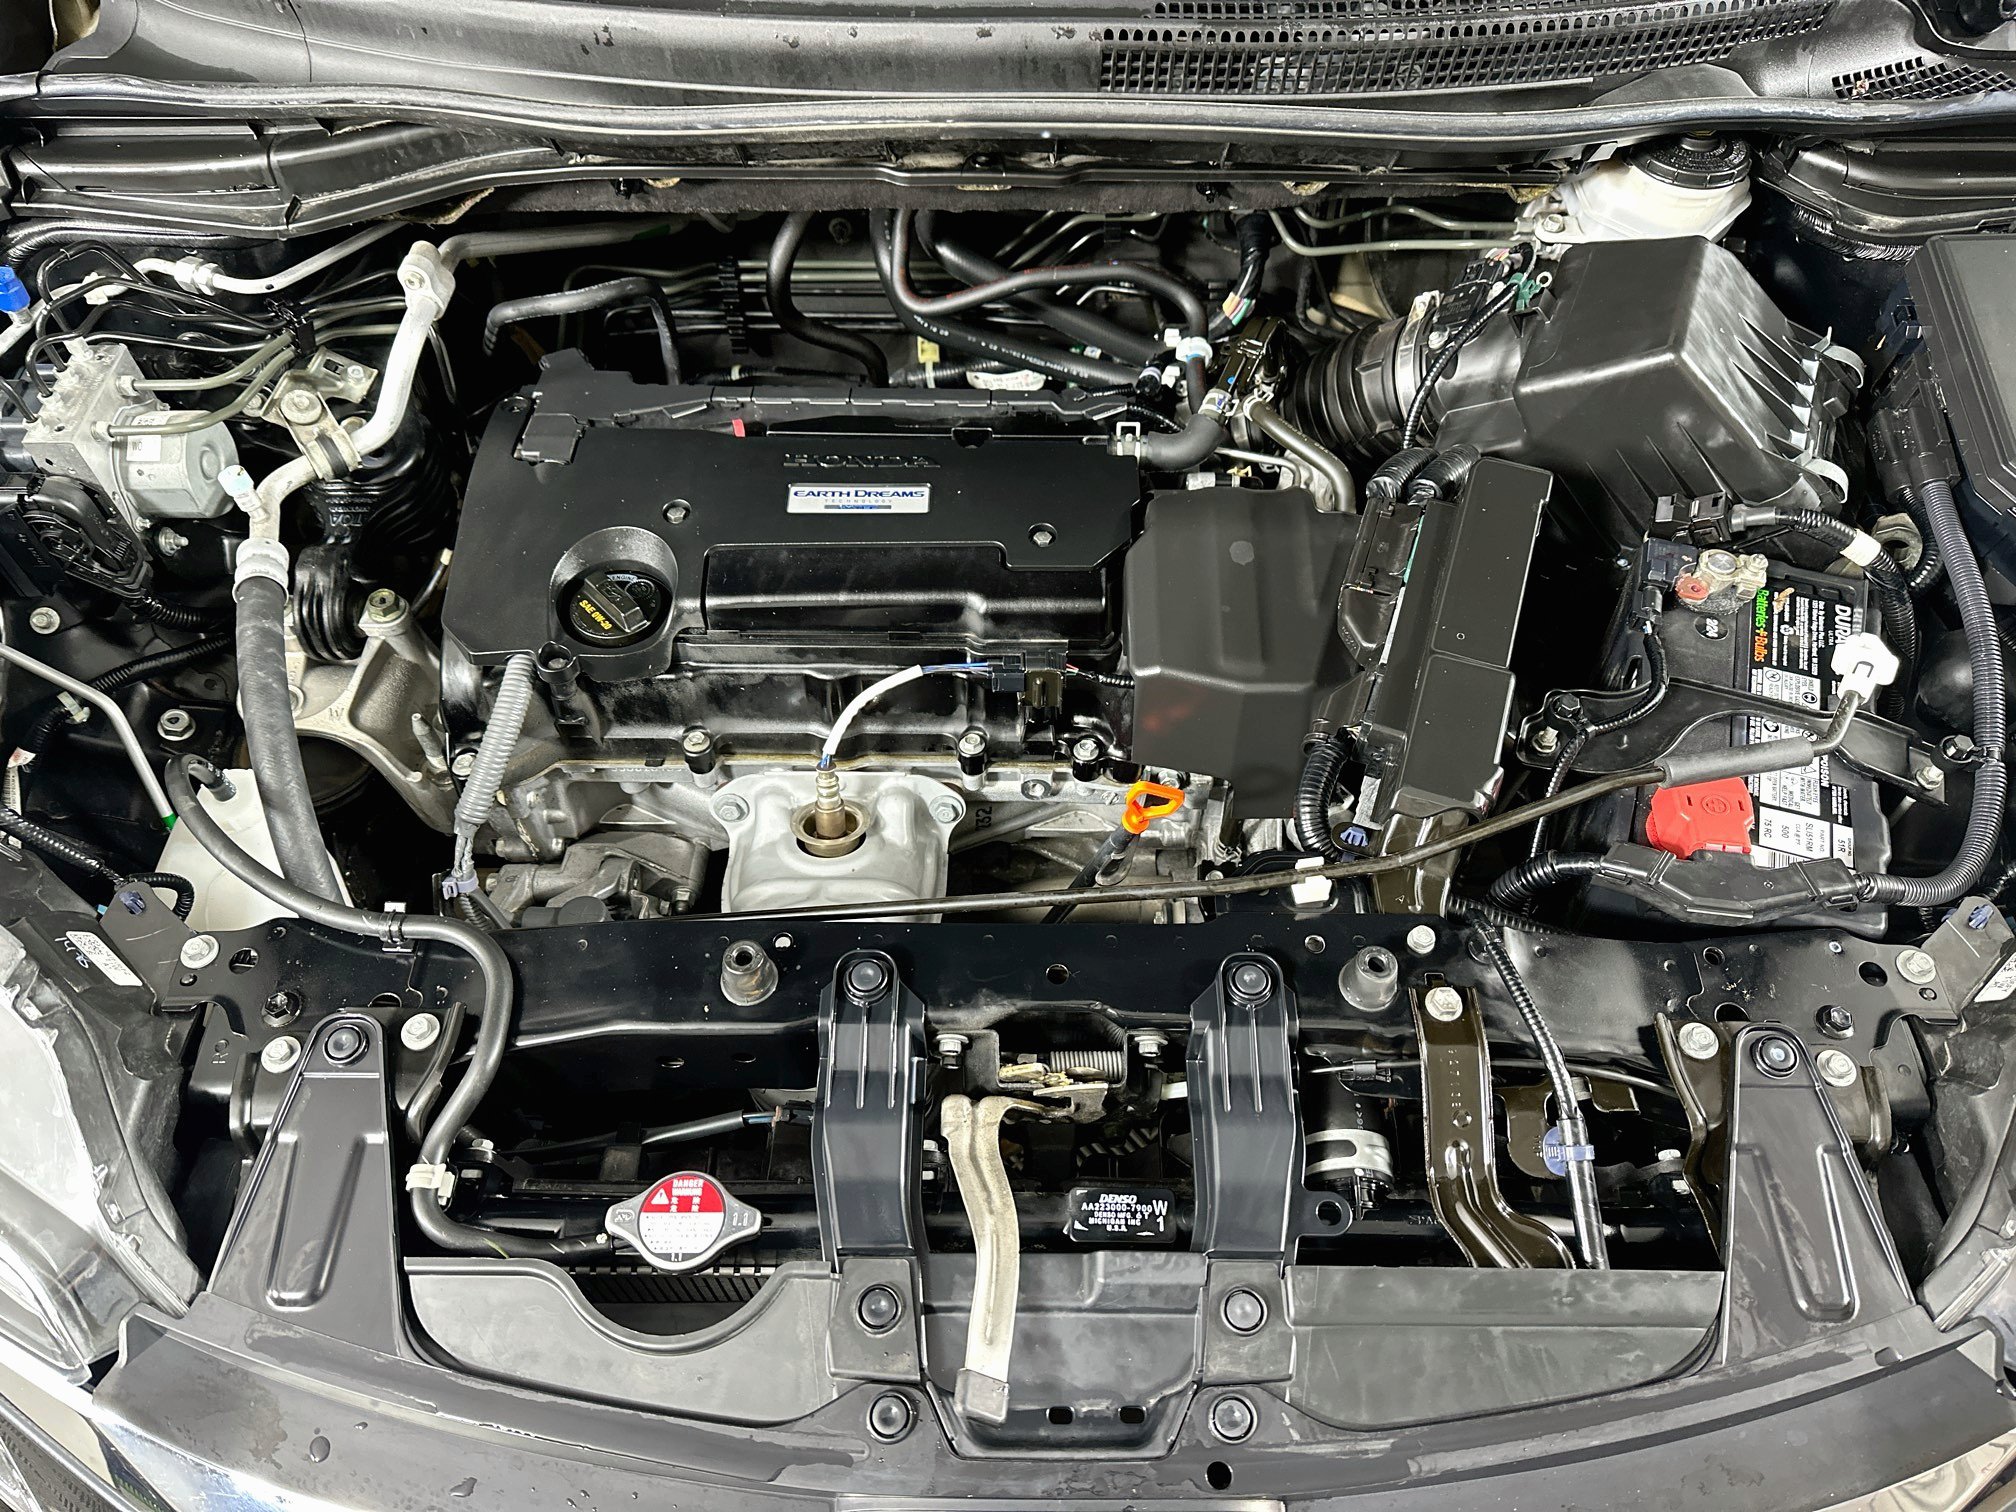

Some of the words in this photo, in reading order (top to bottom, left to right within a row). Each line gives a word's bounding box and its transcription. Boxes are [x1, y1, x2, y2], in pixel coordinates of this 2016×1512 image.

[783, 453, 941, 468] HONDA
[793, 489, 850, 498] EARTH
[854, 489, 925, 498] DREAMS
[579, 600, 596, 614] SAE
[591, 611, 613, 630] 0W-20
[1834, 604, 1852, 646] DURA
[1820, 755, 1830, 788] POISON
[1764, 819, 1772, 827] 75
[1764, 827, 1772, 839] RC
[1838, 839, 1846, 853] 51R
[672, 1179, 704, 1188] DANGER
[1099, 1193, 1137, 1204] DENSO
[1081, 1202, 1153, 1213] AA223000-7900
[1152, 1199, 1168, 1216] W
[732, 1211, 749, 1227] 1.1
[1088, 1217, 1126, 1225] MICHIGAN
[1156, 1215, 1165, 1232] 1
